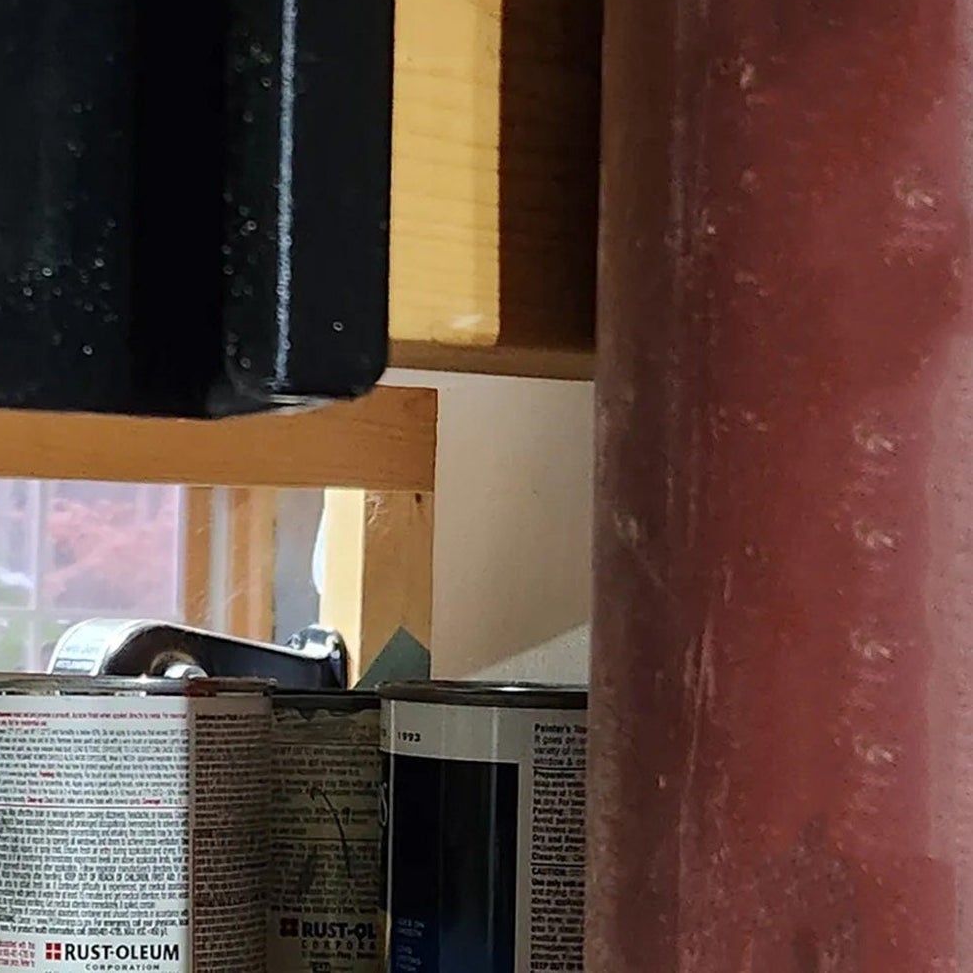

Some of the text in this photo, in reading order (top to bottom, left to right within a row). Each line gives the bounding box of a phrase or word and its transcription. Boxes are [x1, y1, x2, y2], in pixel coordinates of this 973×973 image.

[534, 747, 560, 757] variety
[534, 757, 564, 766] window
[64, 942, 180, 961] RUST-OLEUM
[85, 963, 160, 972] CORPORATION
